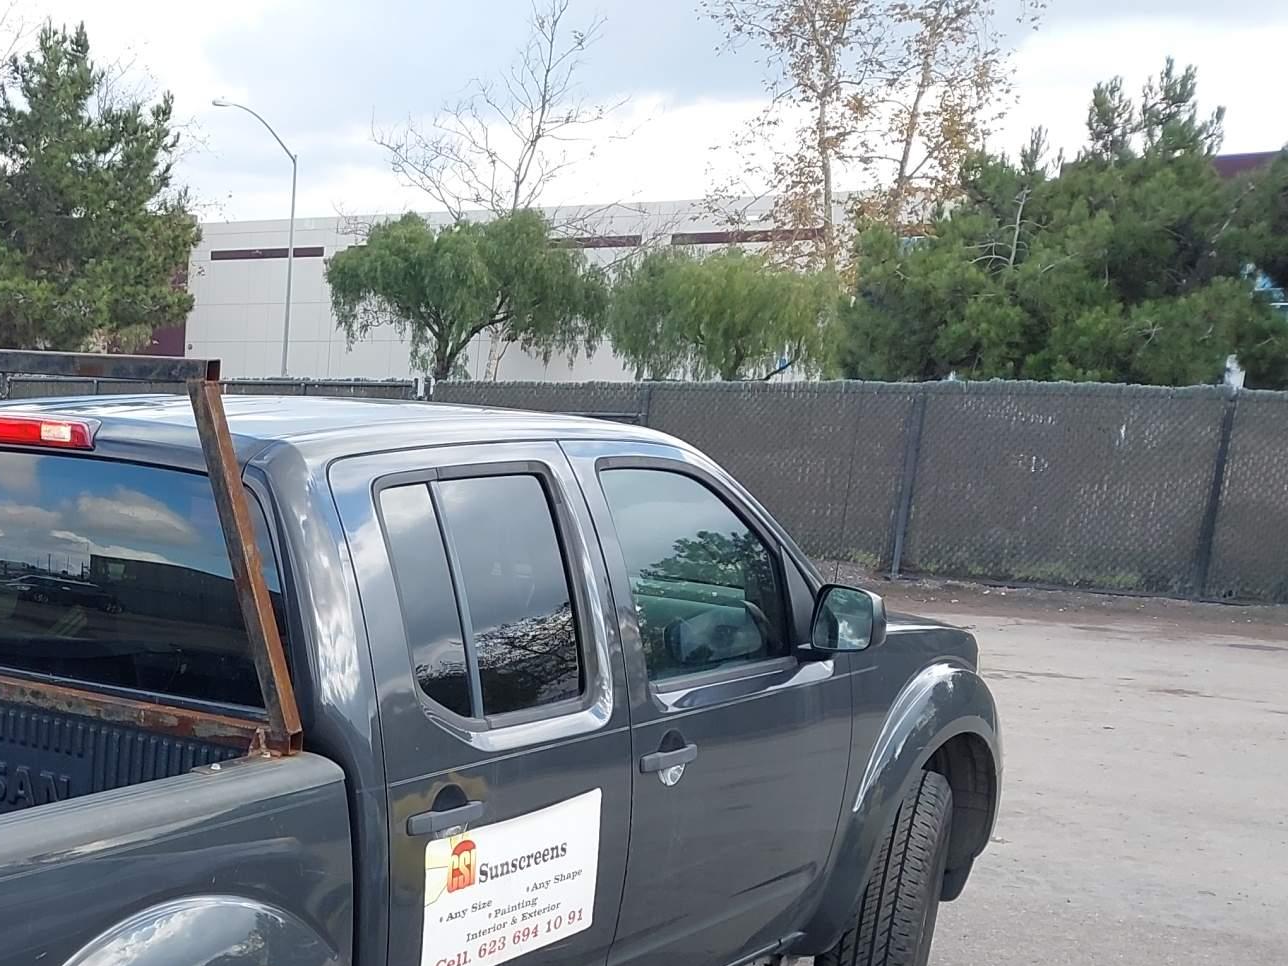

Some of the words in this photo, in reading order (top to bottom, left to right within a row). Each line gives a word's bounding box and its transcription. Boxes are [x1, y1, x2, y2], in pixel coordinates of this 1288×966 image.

[478, 842, 568, 884] Sunscreens
[531, 881, 552, 892] Any
[553, 869, 583, 884] Shape
[445, 907, 468, 922] Any
[471, 899, 492, 912] Size
[466, 919, 508, 943] Interior
[521, 901, 562, 922] Exterior
[493, 897, 539, 919] Painting
[478, 935, 507, 959] 623
[512, 923, 540, 945] 694
[545, 915, 563, 933] 10
[567, 907, 584, 926] 91
